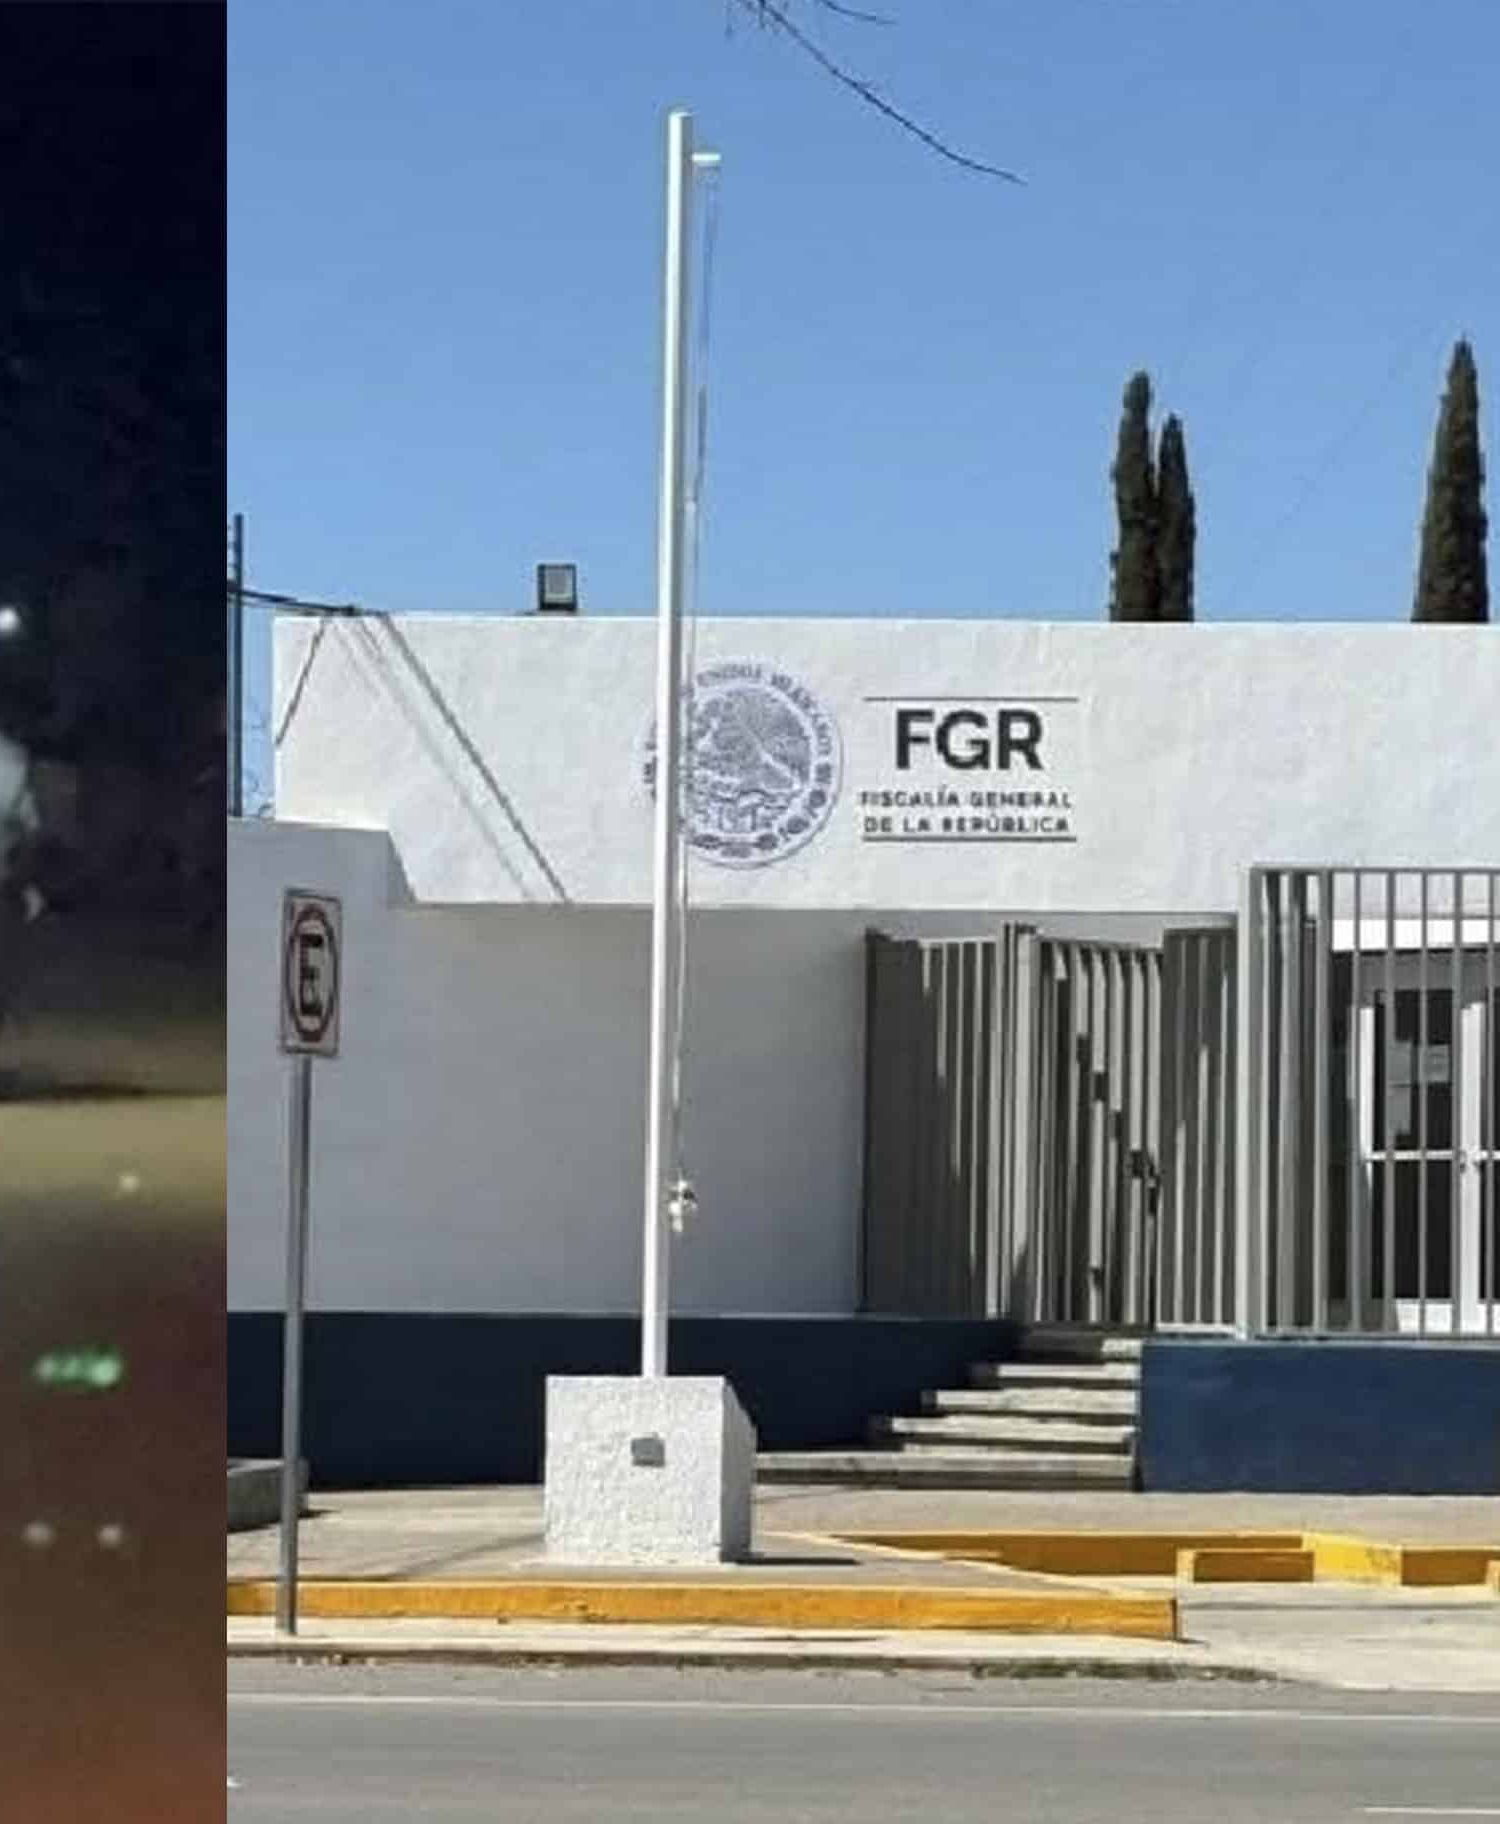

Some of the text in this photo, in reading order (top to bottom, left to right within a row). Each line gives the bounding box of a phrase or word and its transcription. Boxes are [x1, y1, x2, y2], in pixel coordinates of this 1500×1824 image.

[896, 708, 1044, 770] FGR
[861, 784, 1072, 808] FISCALÍA GENERAL
[864, 813, 1069, 833] DE LA REPÚBLICA
[299, 932, 325, 1018] E
